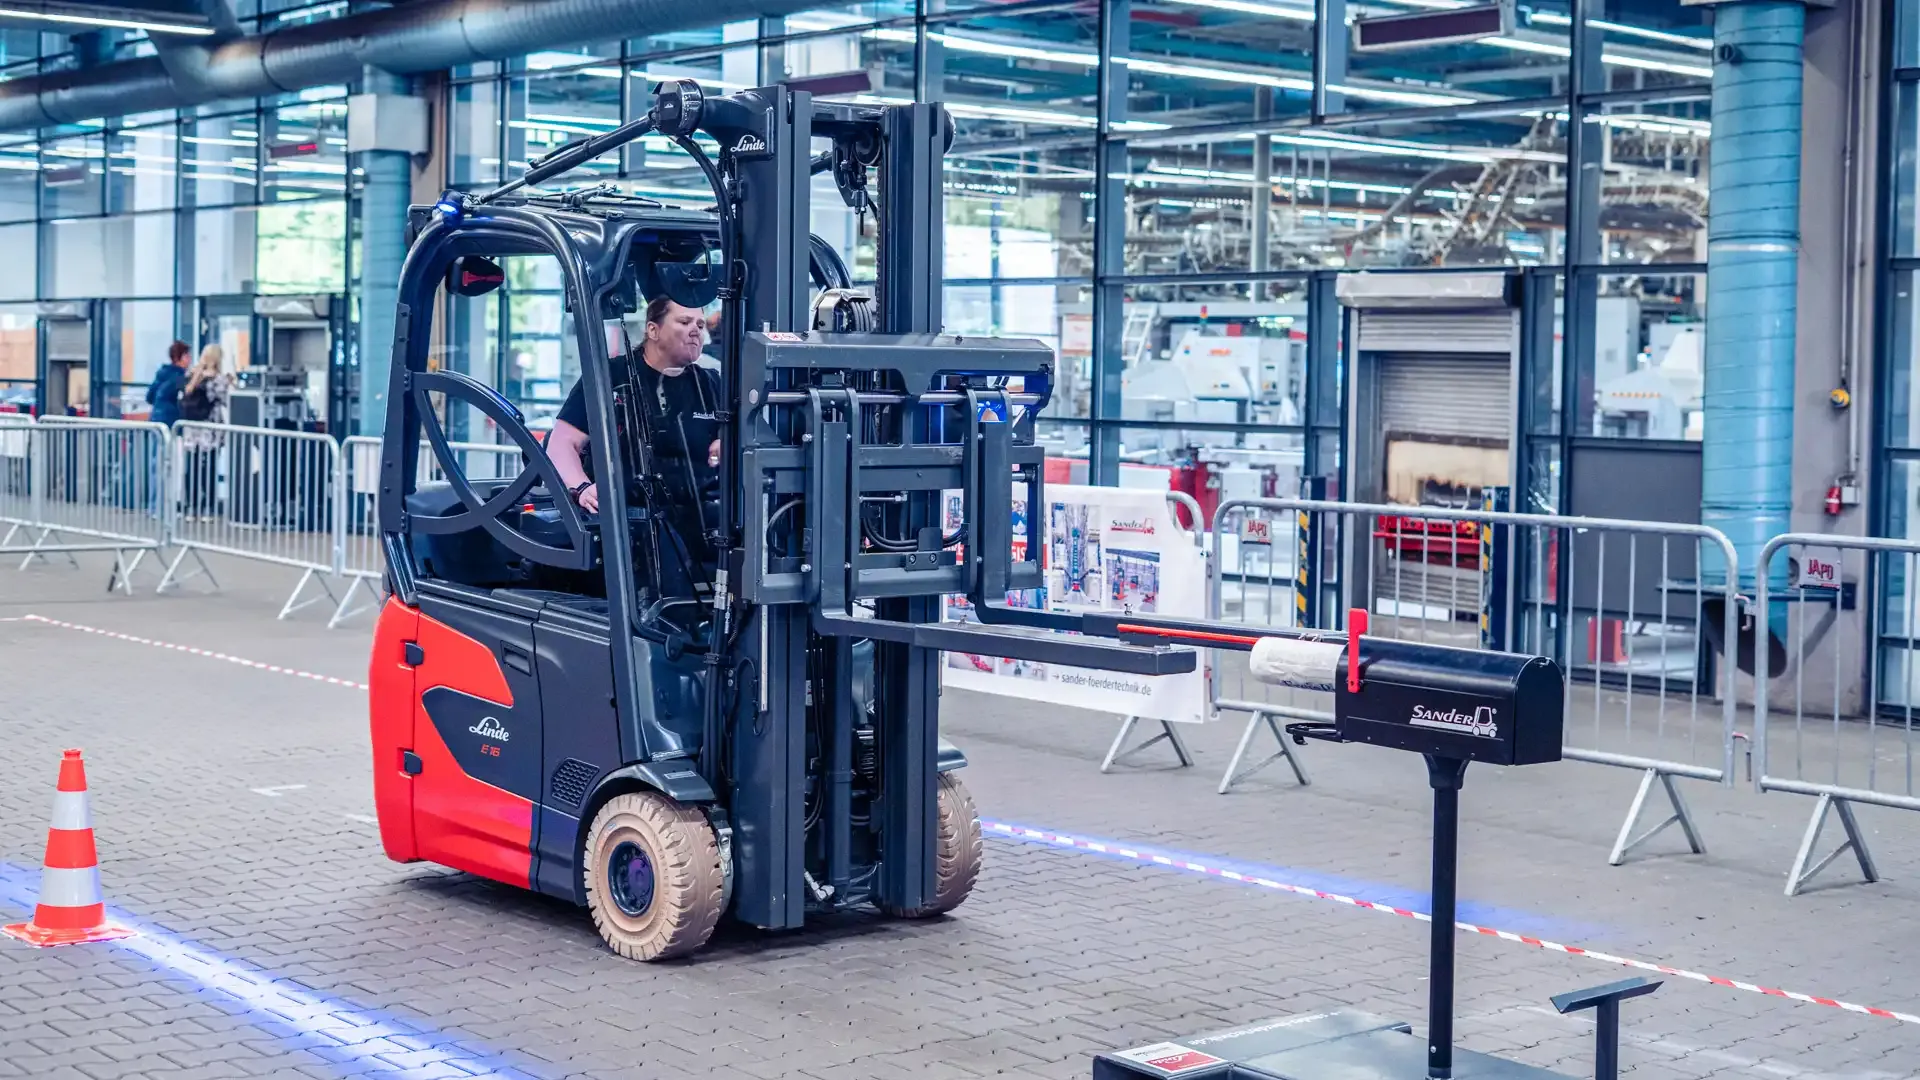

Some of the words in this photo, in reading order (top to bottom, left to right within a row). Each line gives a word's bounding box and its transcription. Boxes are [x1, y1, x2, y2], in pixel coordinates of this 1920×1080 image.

[730, 134, 765, 152] Linde
[468, 716, 510, 742] Linde
[480, 743, 490, 755] E
